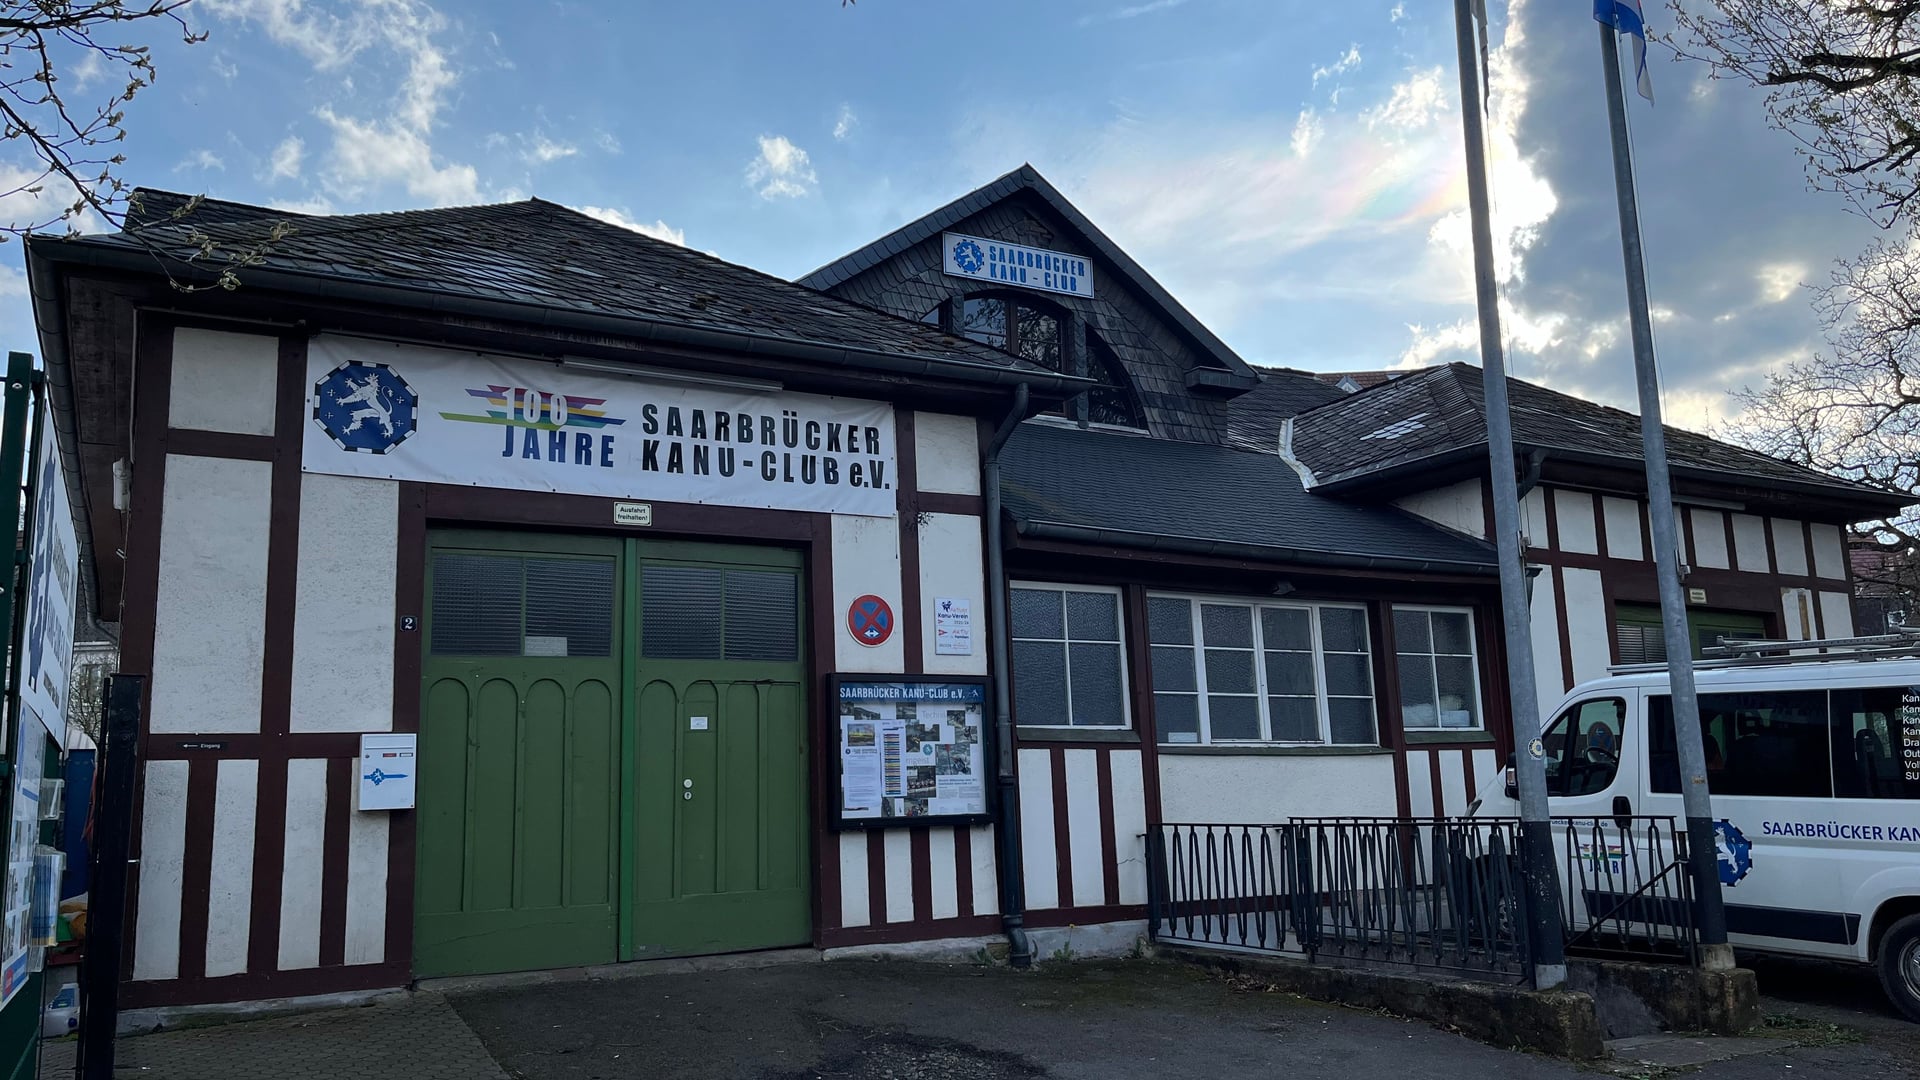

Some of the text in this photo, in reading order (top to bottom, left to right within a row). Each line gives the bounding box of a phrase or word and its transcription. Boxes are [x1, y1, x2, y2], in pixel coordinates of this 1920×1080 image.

[989, 245, 1085, 277] SAARBRÜCKER
[502, 386, 568, 426] 100
[641, 403, 880, 455] SAARBRÜCKER
[502, 425, 615, 468] JAHRE
[641, 439, 890, 490] KANU-CLUB e.V.
[620, 506, 646, 514] Ausfahrt
[405, 617, 413, 630] 2
[839, 686, 966, 699] SAARBRÜCKER KANU-CLUB e.V.
[1762, 820, 1884, 840] SAARBRÜCKER
